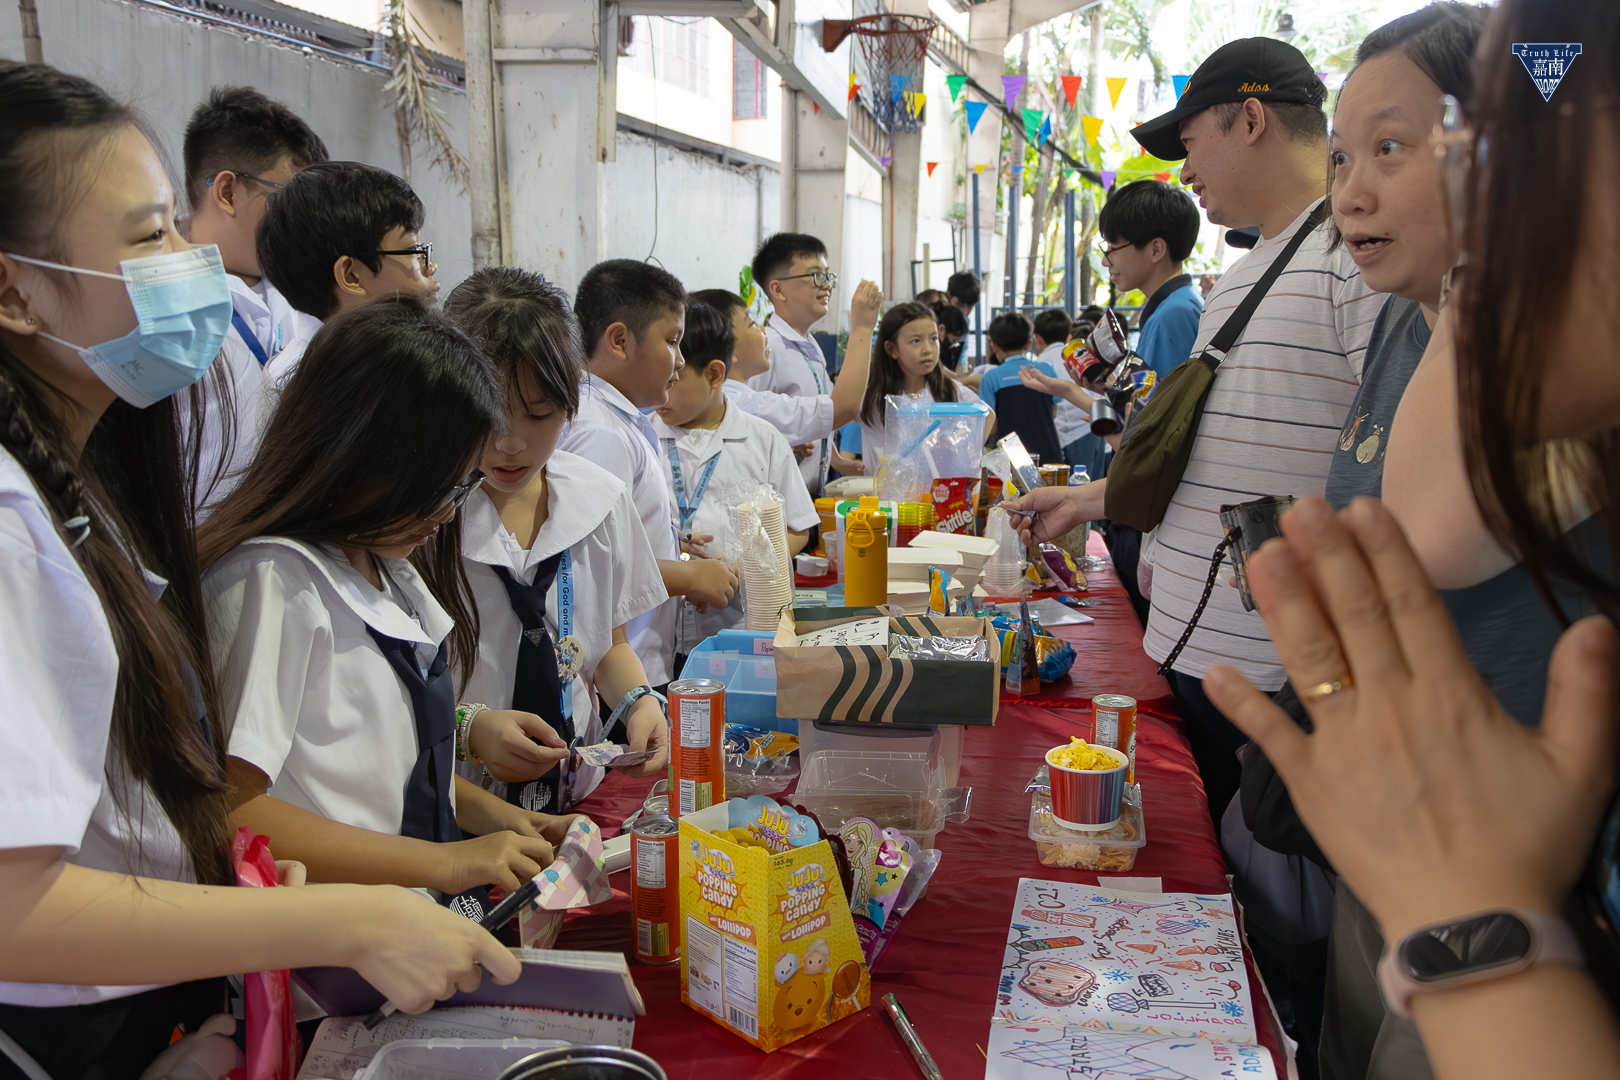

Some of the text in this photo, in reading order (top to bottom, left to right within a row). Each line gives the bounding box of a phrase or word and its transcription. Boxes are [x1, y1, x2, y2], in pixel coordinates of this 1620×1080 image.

[562, 587, 570, 606] God
[562, 608, 570, 626] and
[763, 665, 769, 674] 5
[697, 871, 738, 896] POPPING
[780, 884, 826, 912] POPPING
[1034, 886, 1066, 909] C2!
[1077, 983, 1101, 1007] COOKIES
[1147, 1013, 1248, 1026] LOLLIPOP
[1070, 1036, 1093, 1074] STARZ
